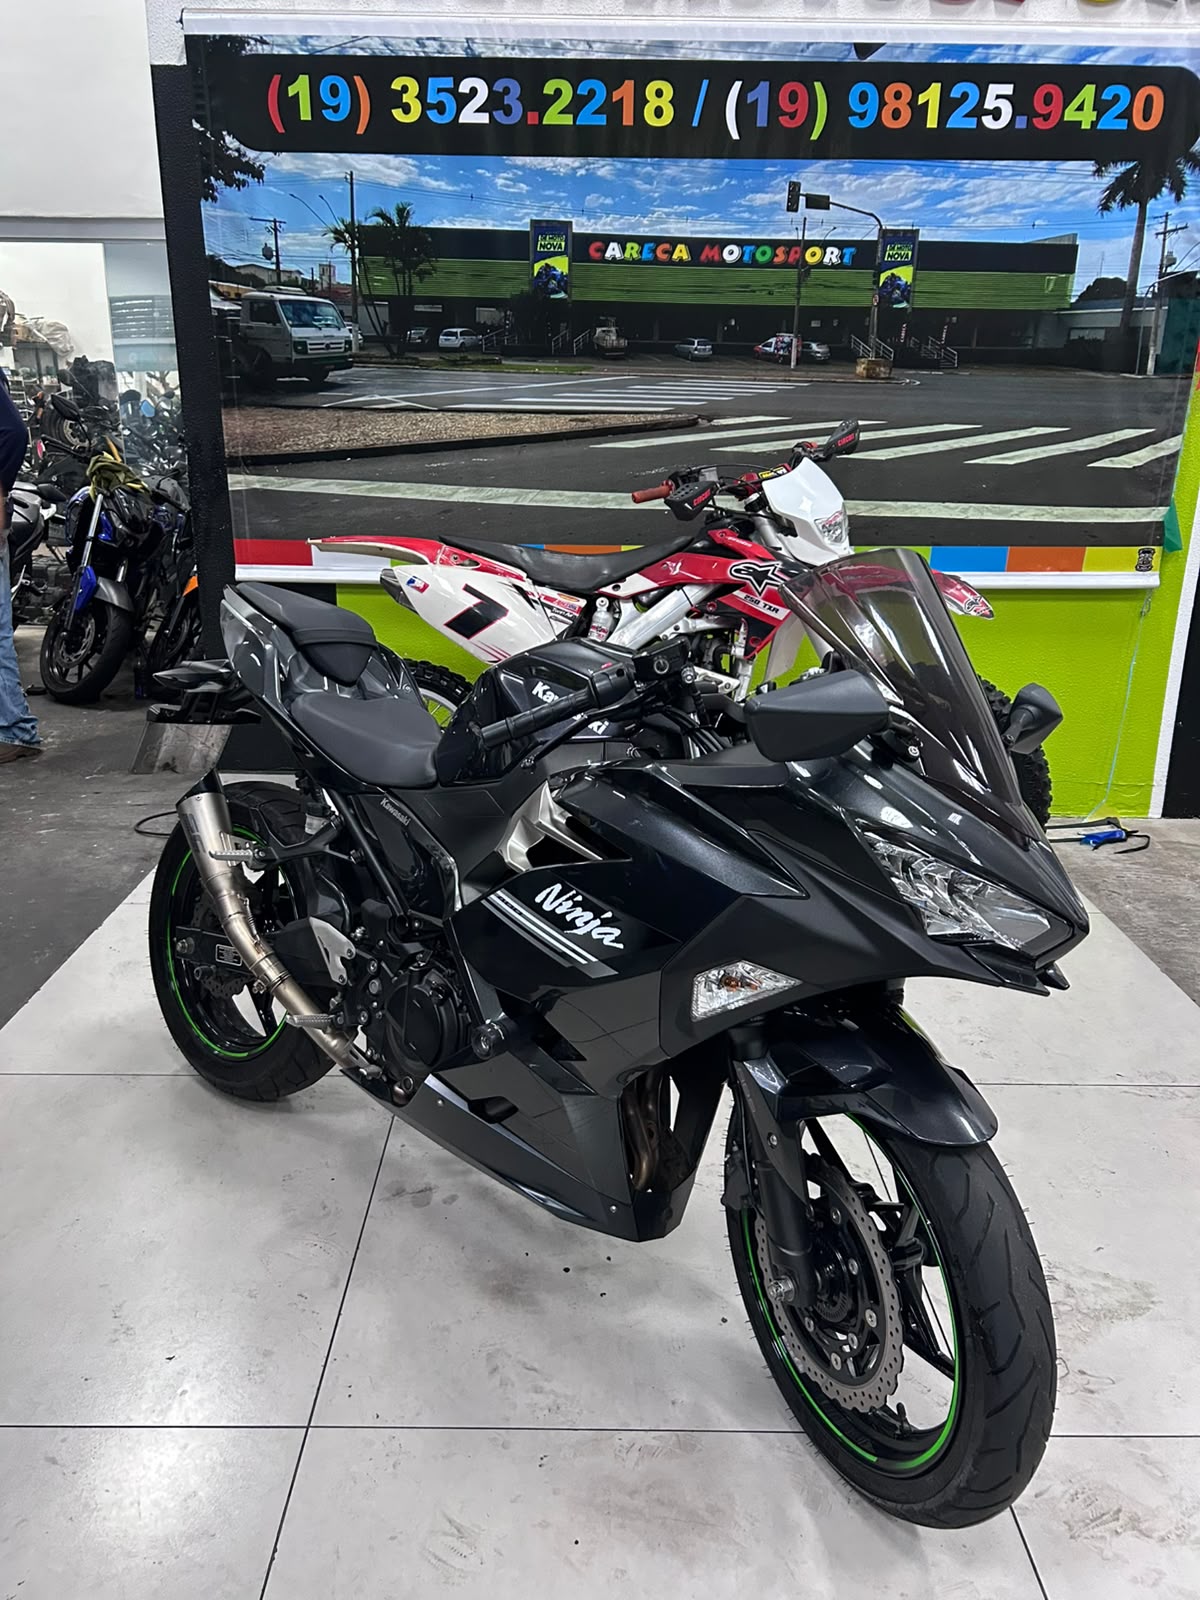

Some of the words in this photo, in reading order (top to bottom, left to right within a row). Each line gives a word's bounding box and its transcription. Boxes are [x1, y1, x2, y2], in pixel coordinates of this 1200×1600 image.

[268, 74, 371, 135] (19)
[391, 76, 675, 127] 3523.2218
[726, 80, 828, 141] (19)
[848, 81, 1165, 131] 98125.9420
[539, 242, 563, 250] NOVA
[588, 242, 692, 262] CARECA
[700, 244, 857, 266] MOTOSPORT
[887, 251, 910, 260] NOVA
[744, 594, 760, 605] 250
[380, 797, 411, 826] Kawasaki
[534, 883, 624, 949] Ninja
